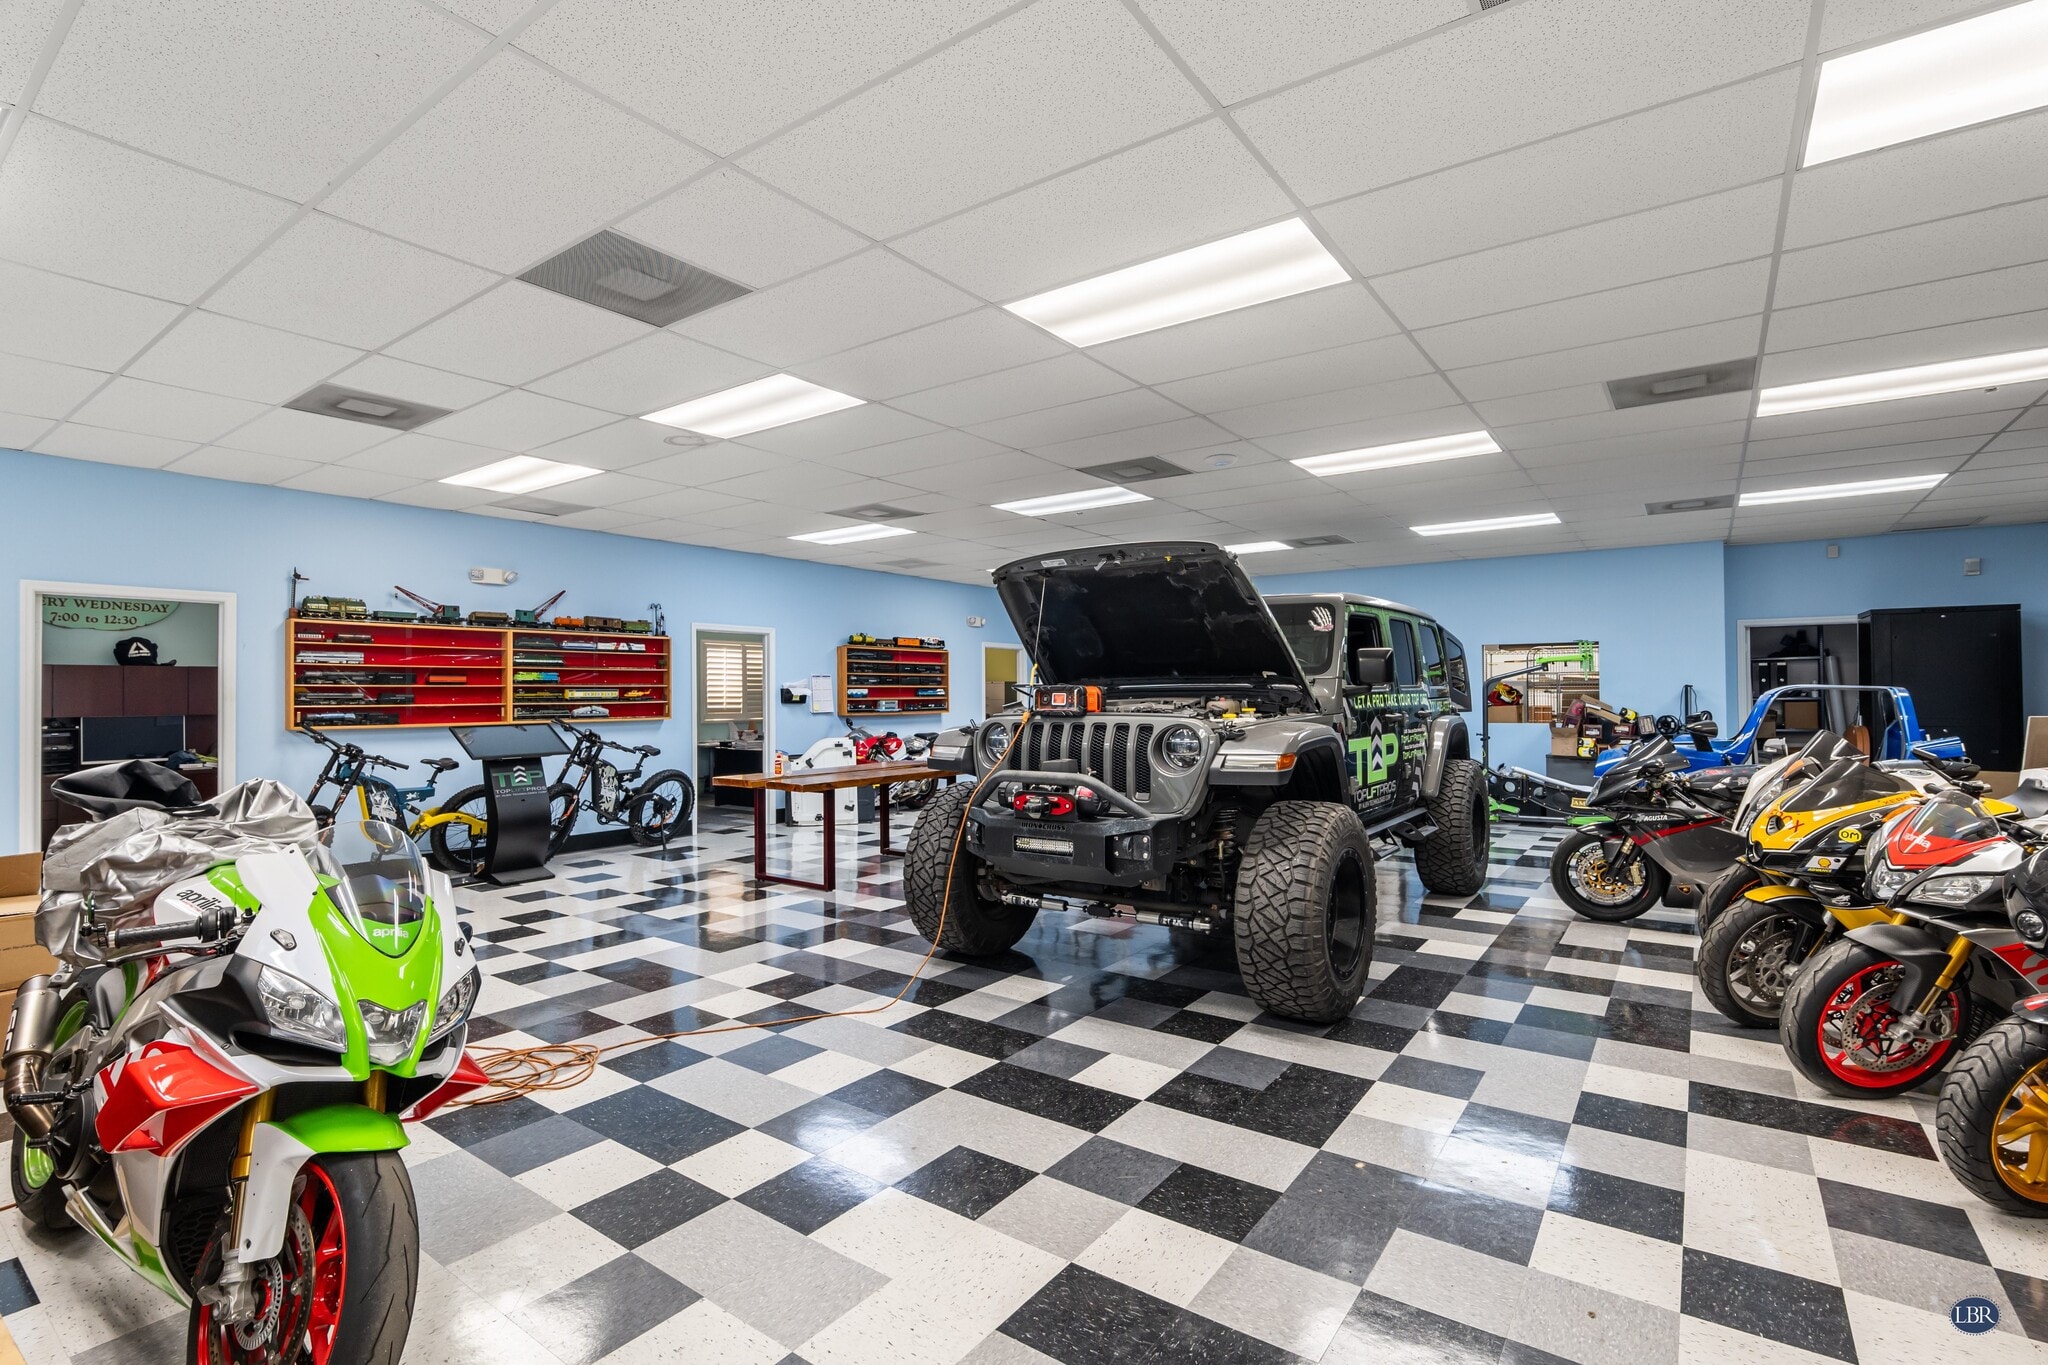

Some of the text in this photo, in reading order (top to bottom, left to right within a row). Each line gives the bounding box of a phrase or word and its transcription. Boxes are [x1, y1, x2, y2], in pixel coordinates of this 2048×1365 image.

[42, 596, 170, 613] ERY WEDNESDAY
[50, 612, 138, 625] 7:00 to 12:30
[1354, 695, 1365, 709] LET
[1366, 695, 1372, 708] A
[1372, 694, 1385, 708] PRO
[1385, 693, 1398, 707] TAKE
[1643, 814, 1668, 822] AGUSTA
[1841, 830, 1860, 840] OM
[1020, 897, 1039, 907] FOX
[373, 928, 409, 939] aprilia
